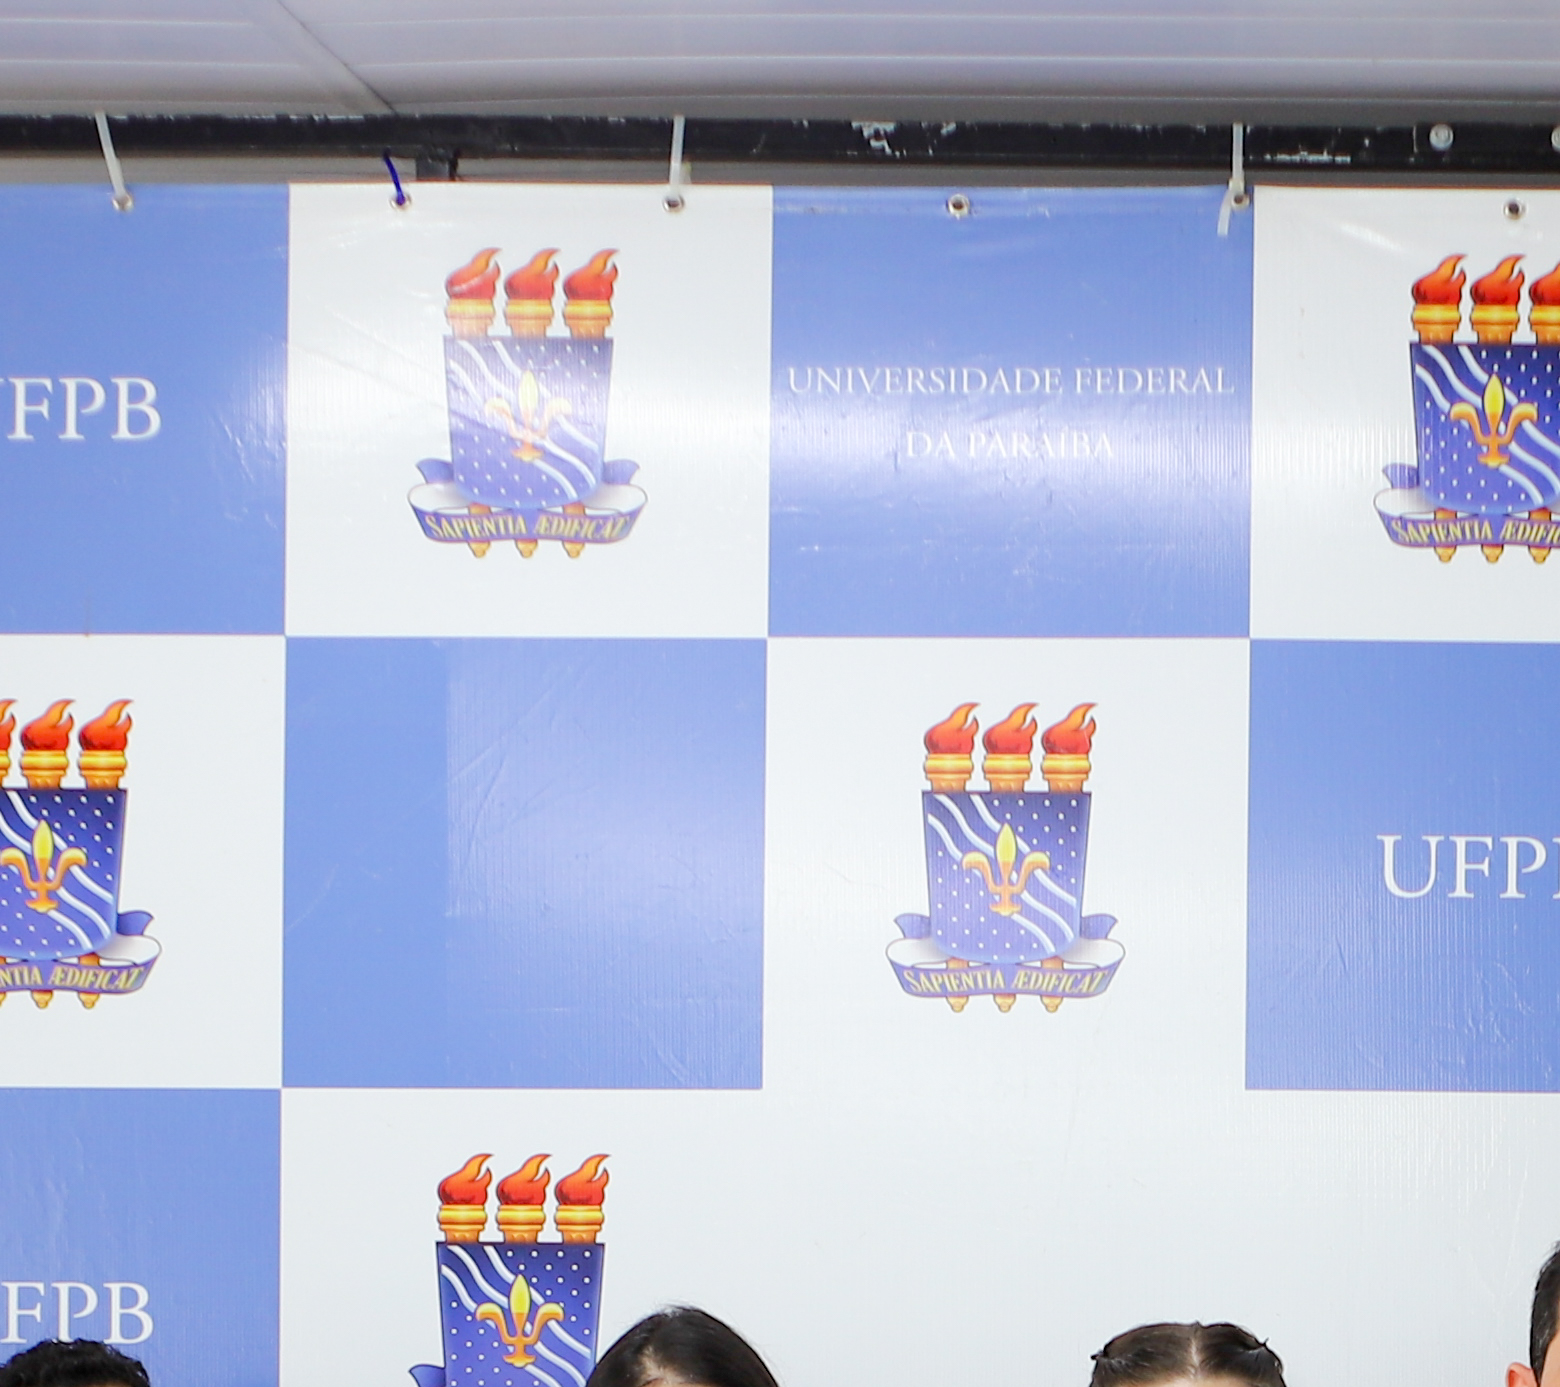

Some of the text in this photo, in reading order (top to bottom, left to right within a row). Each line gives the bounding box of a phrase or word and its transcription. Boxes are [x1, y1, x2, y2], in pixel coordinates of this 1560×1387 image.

[788, 367, 1234, 394] UNIVERSIDADE FEDERAL
[906, 430, 956, 459] DA
[425, 515, 527, 539] SAPIENTIA
[1391, 519, 1493, 543] SAPIENTIA
[903, 969, 1006, 993] SAPIENTIA
